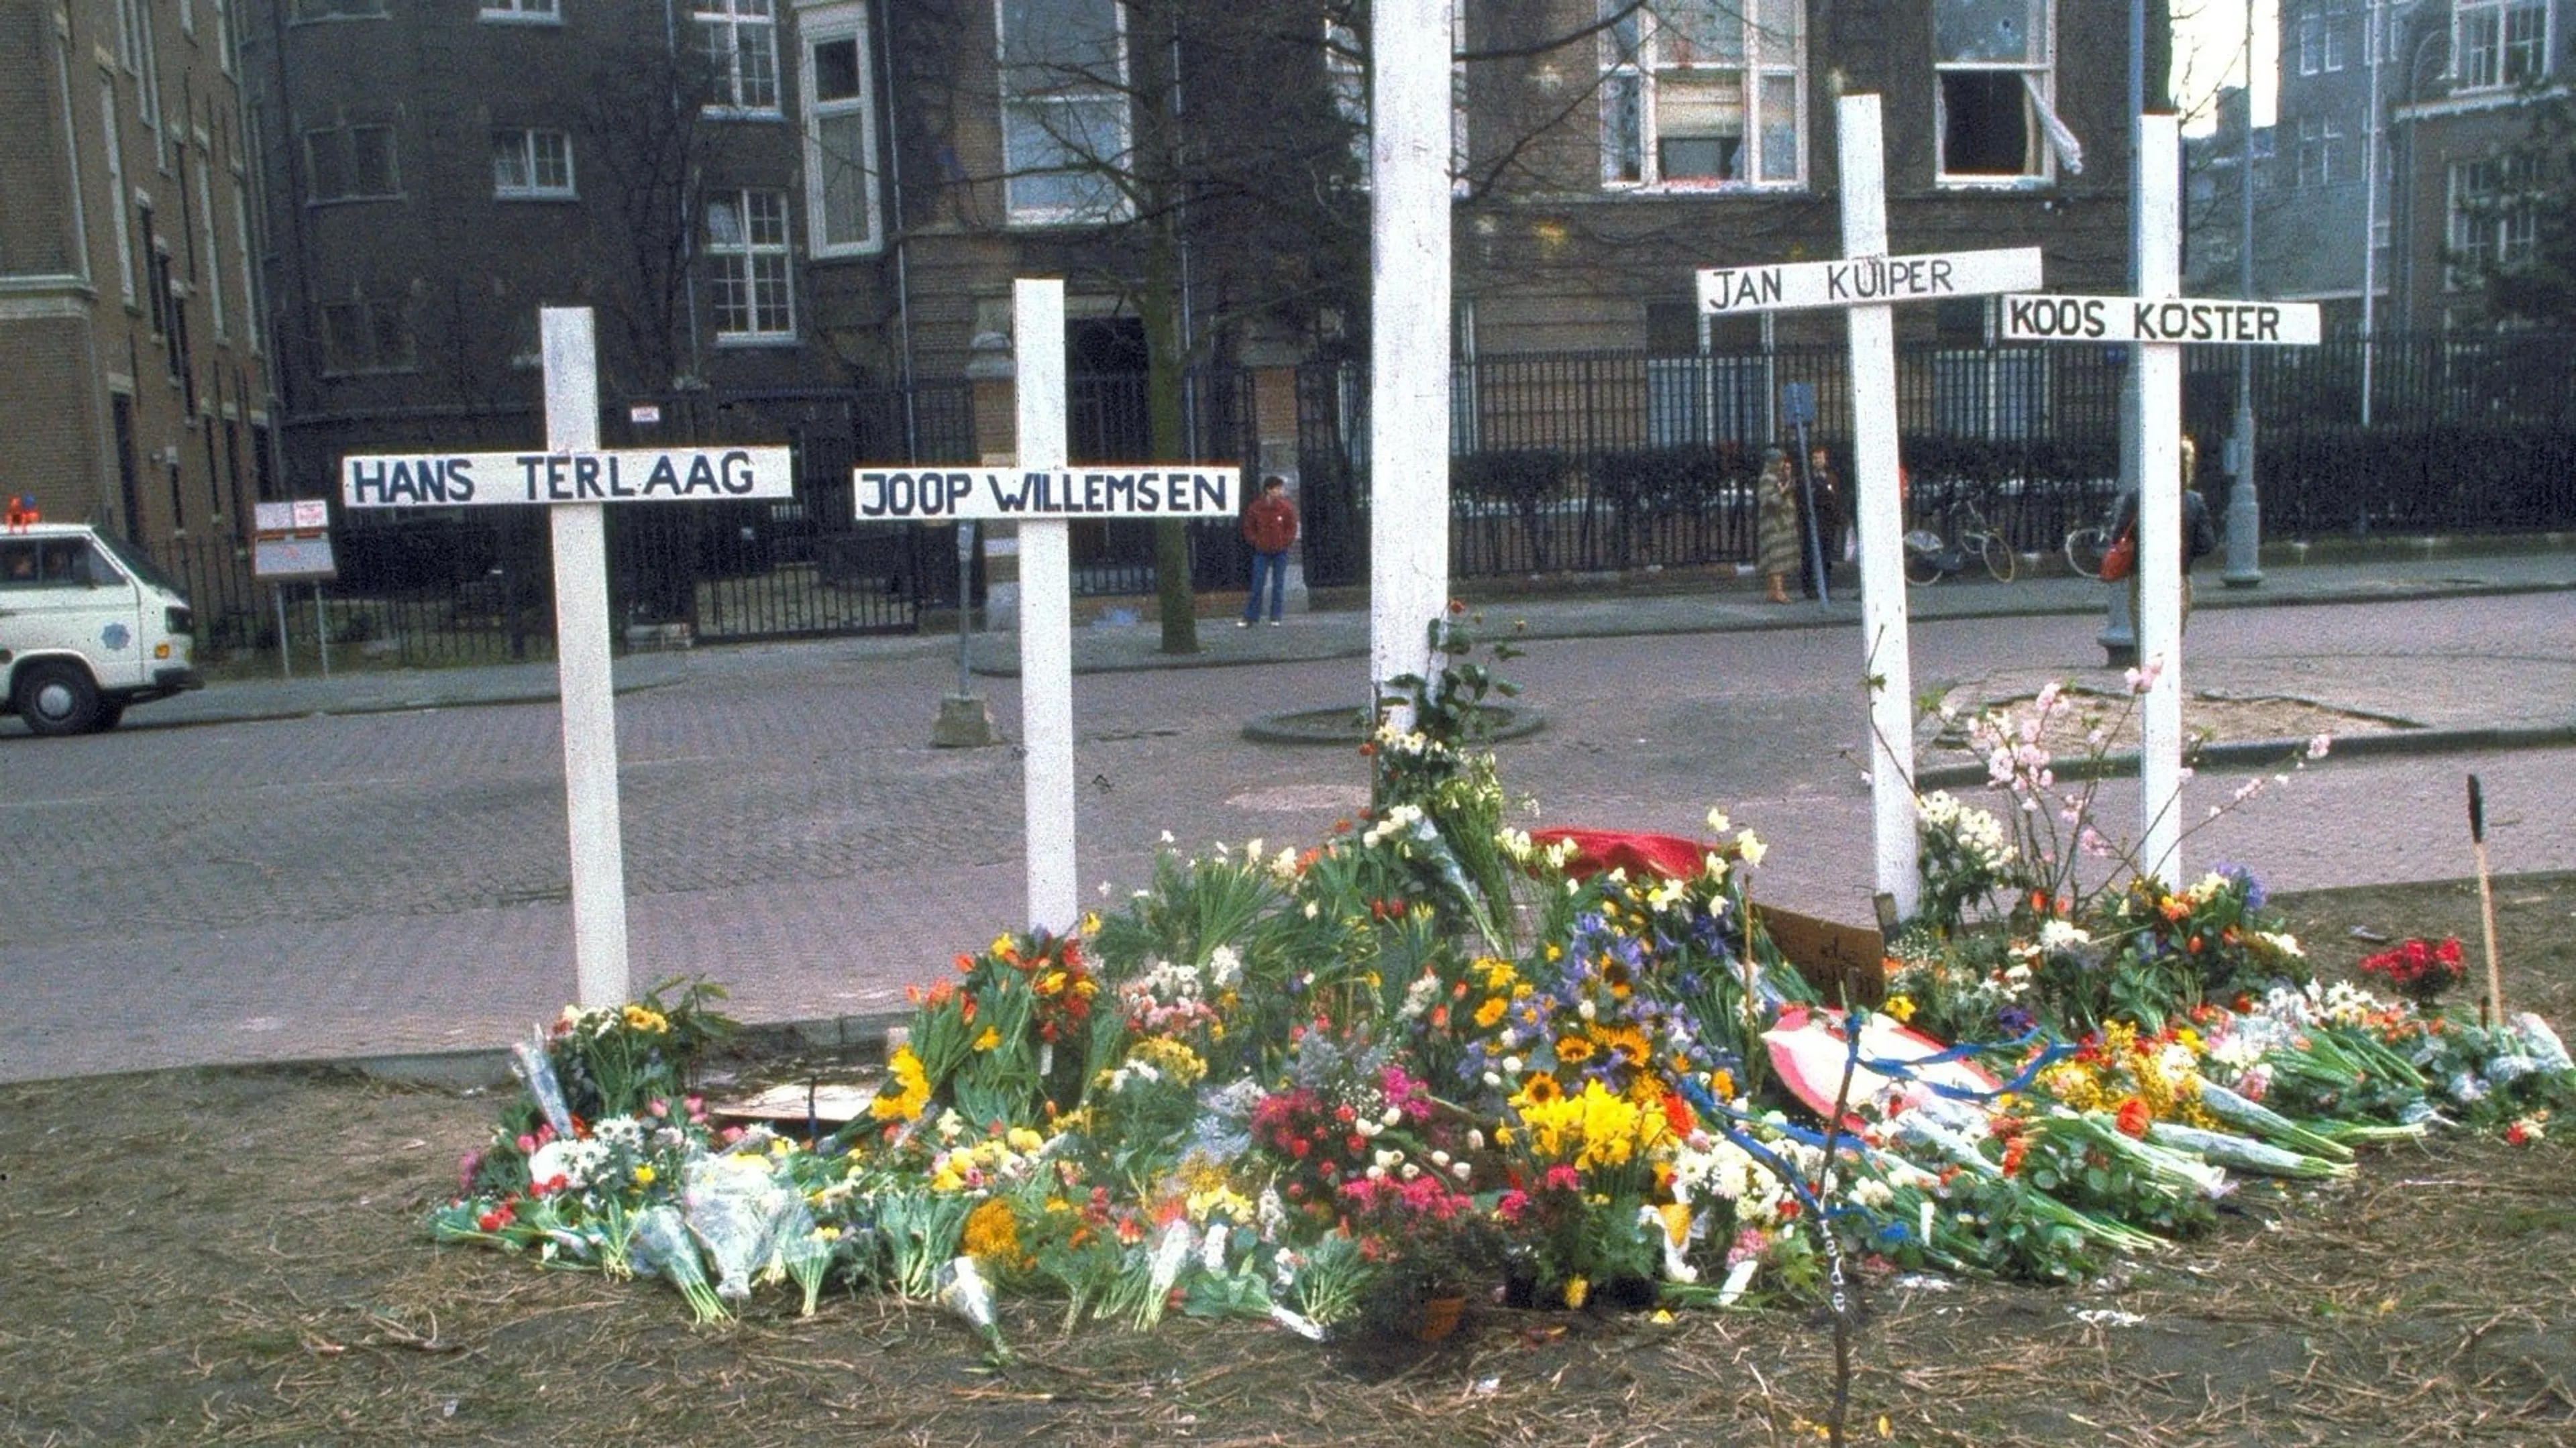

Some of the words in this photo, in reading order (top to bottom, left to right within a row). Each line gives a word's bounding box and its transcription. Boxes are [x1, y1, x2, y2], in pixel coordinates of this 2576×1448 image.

[1709, 268, 1782, 311] JAN
[2011, 299, 2106, 338] KOOS
[2133, 303, 2279, 341] KOSTER
[352, 458, 476, 503] HANS
[516, 451, 754, 501] TERLAAG
[861, 473, 973, 516] JOOP
[986, 473, 1227, 512] WILLEMSEN
